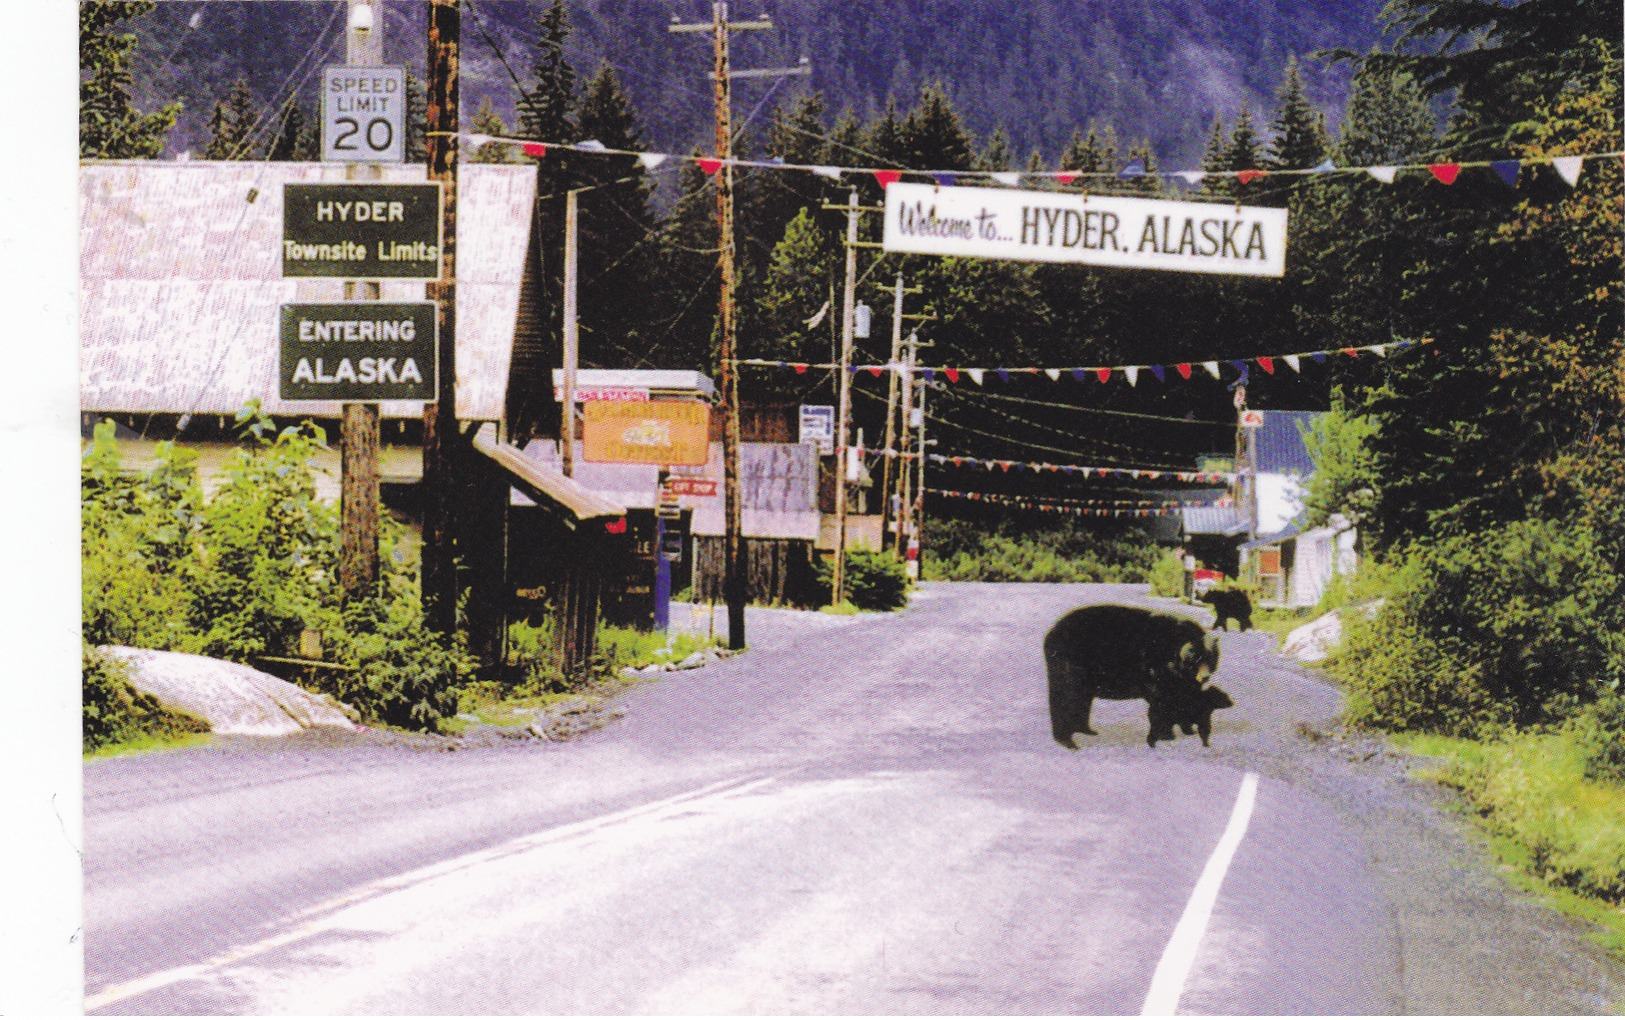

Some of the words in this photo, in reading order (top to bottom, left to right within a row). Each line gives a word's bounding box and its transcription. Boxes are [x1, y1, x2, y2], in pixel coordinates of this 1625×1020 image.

[330, 78, 397, 94] SPEED
[336, 97, 390, 112] LIMIT
[334, 117, 394, 151] 20
[317, 201, 405, 223] HYDER
[898, 200, 974, 240] Welcome
[1137, 213, 1268, 261] ALASKA
[284, 239, 366, 261] Townsite
[378, 239, 438, 261] Limits
[299, 319, 415, 342] ENTERING
[292, 357, 422, 384] ALASKA
